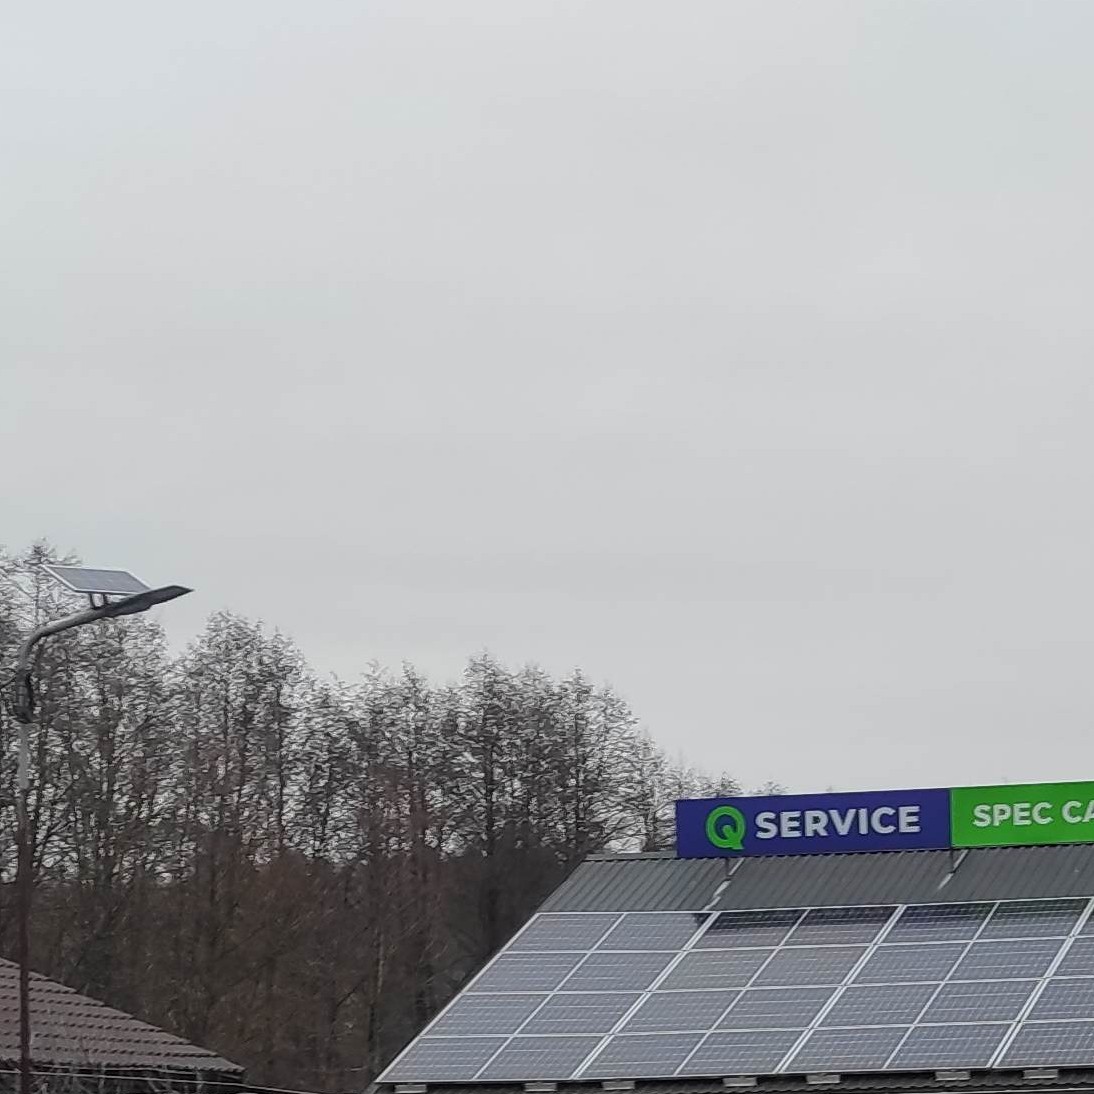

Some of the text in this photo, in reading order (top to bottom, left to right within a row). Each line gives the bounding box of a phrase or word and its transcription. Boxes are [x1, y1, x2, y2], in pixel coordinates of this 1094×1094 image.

[705, 805, 921, 850] Q SERVICE
[972, 801, 1053, 829] SPEC
